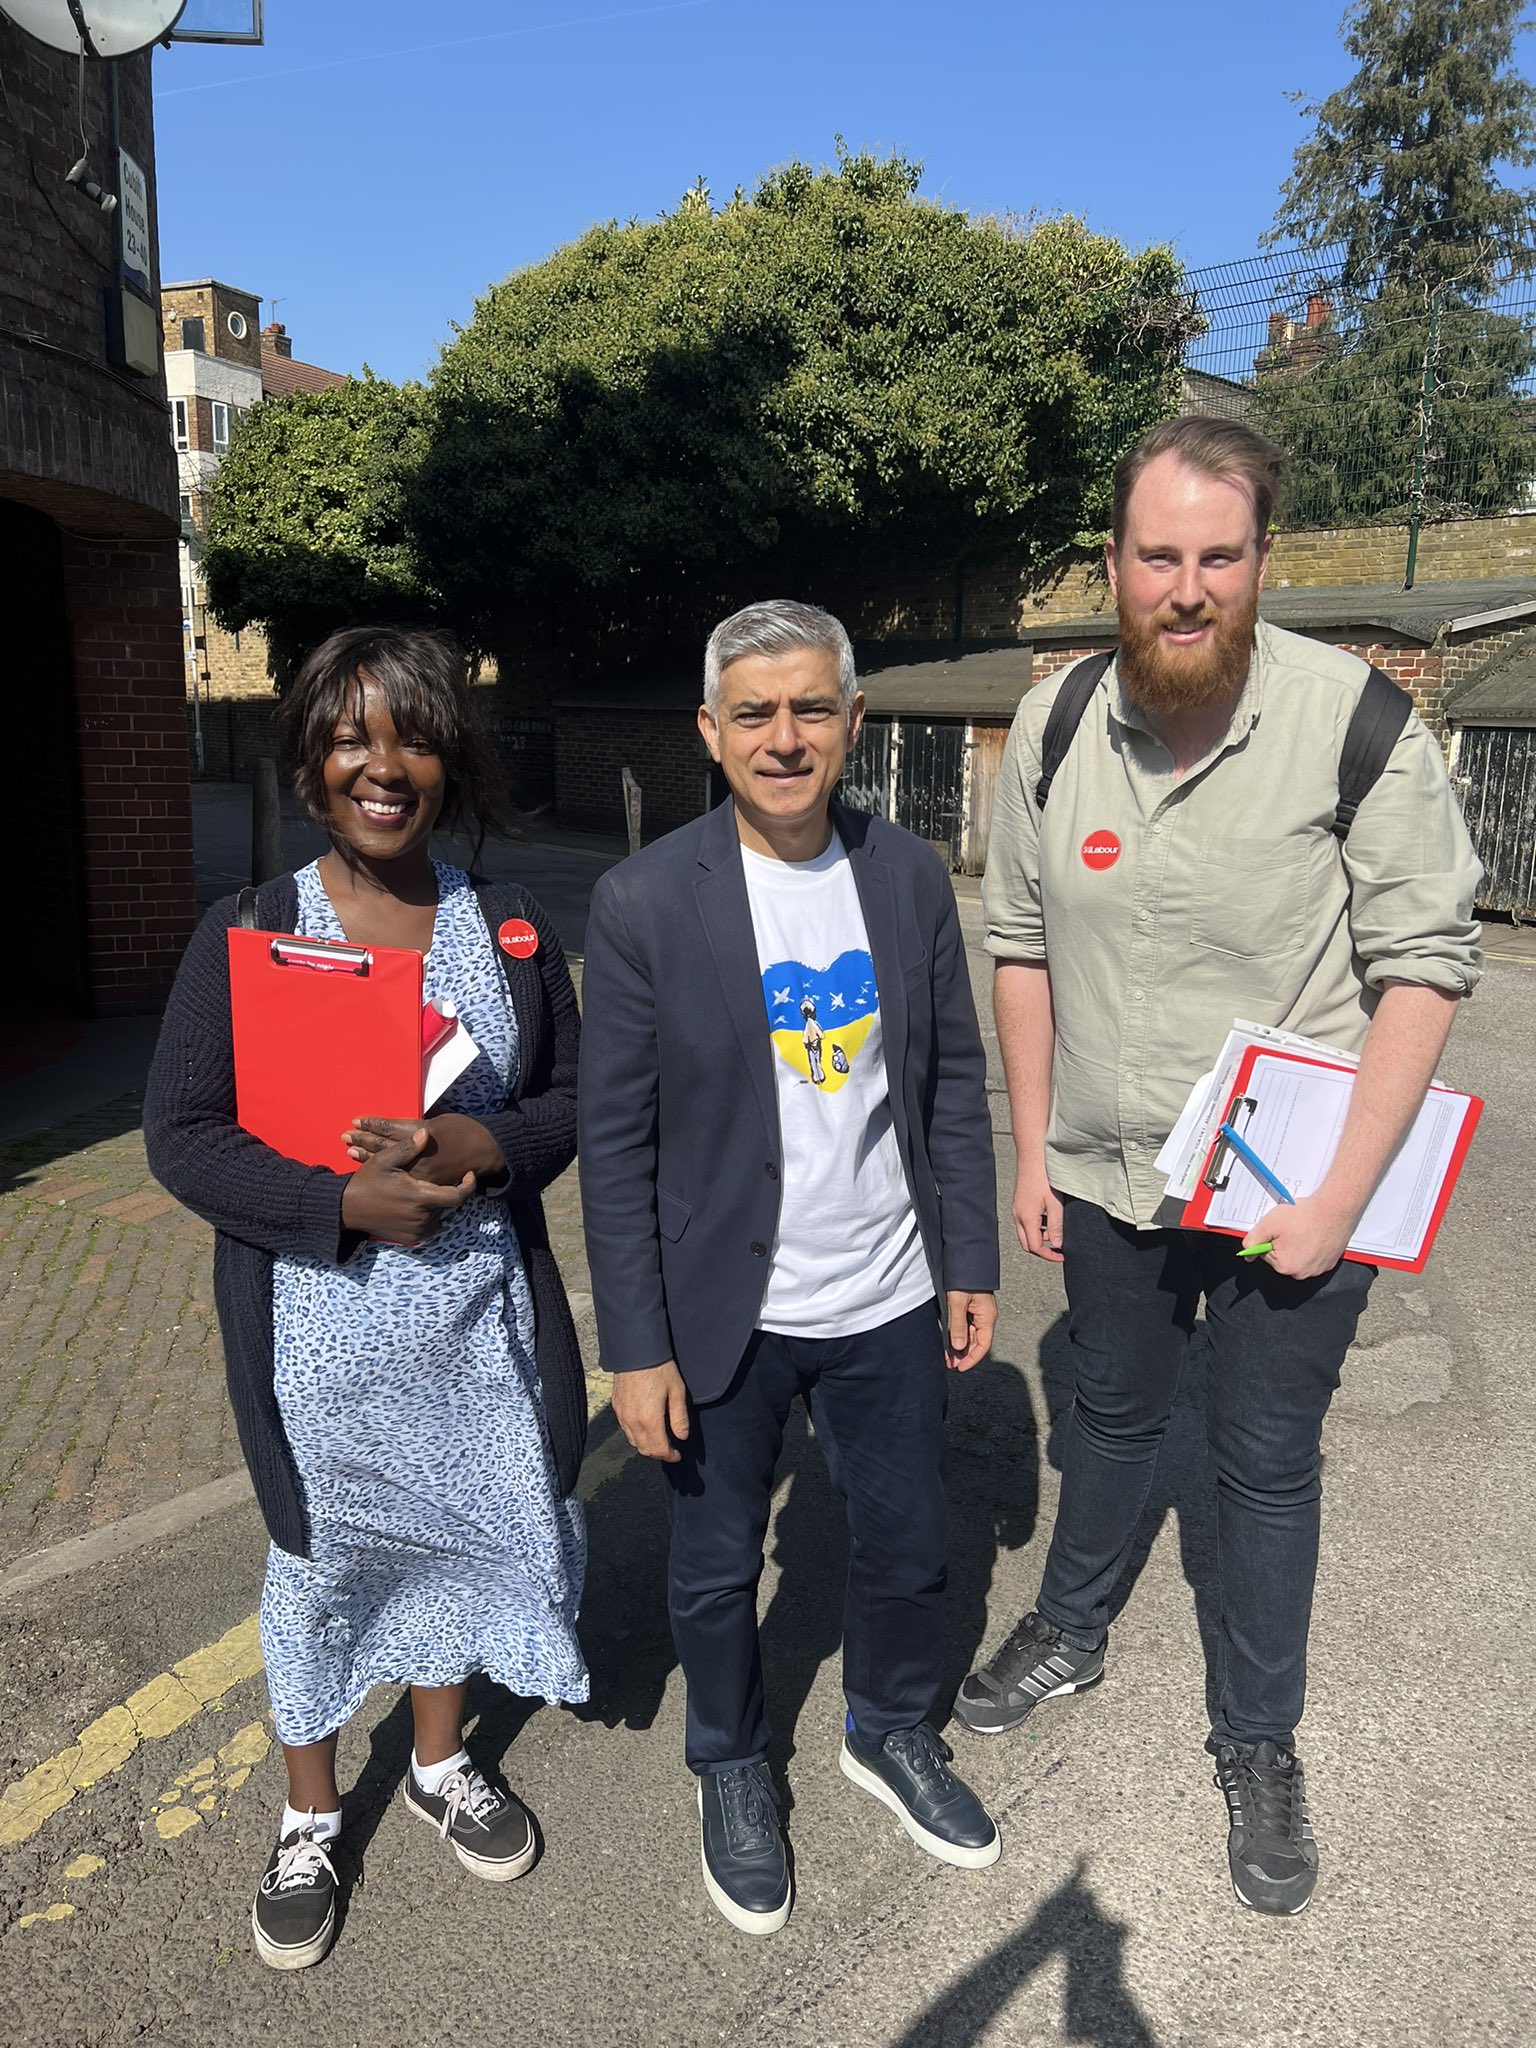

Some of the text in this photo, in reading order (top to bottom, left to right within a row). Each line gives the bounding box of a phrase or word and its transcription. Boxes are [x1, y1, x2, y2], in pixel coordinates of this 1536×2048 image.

[123, 162, 143, 202] Cubitt
[125, 194, 146, 235] House
[514, 720, 530, 732] CAR
[1090, 846, 1119, 854] Labour
[508, 934, 535, 944] Labour
